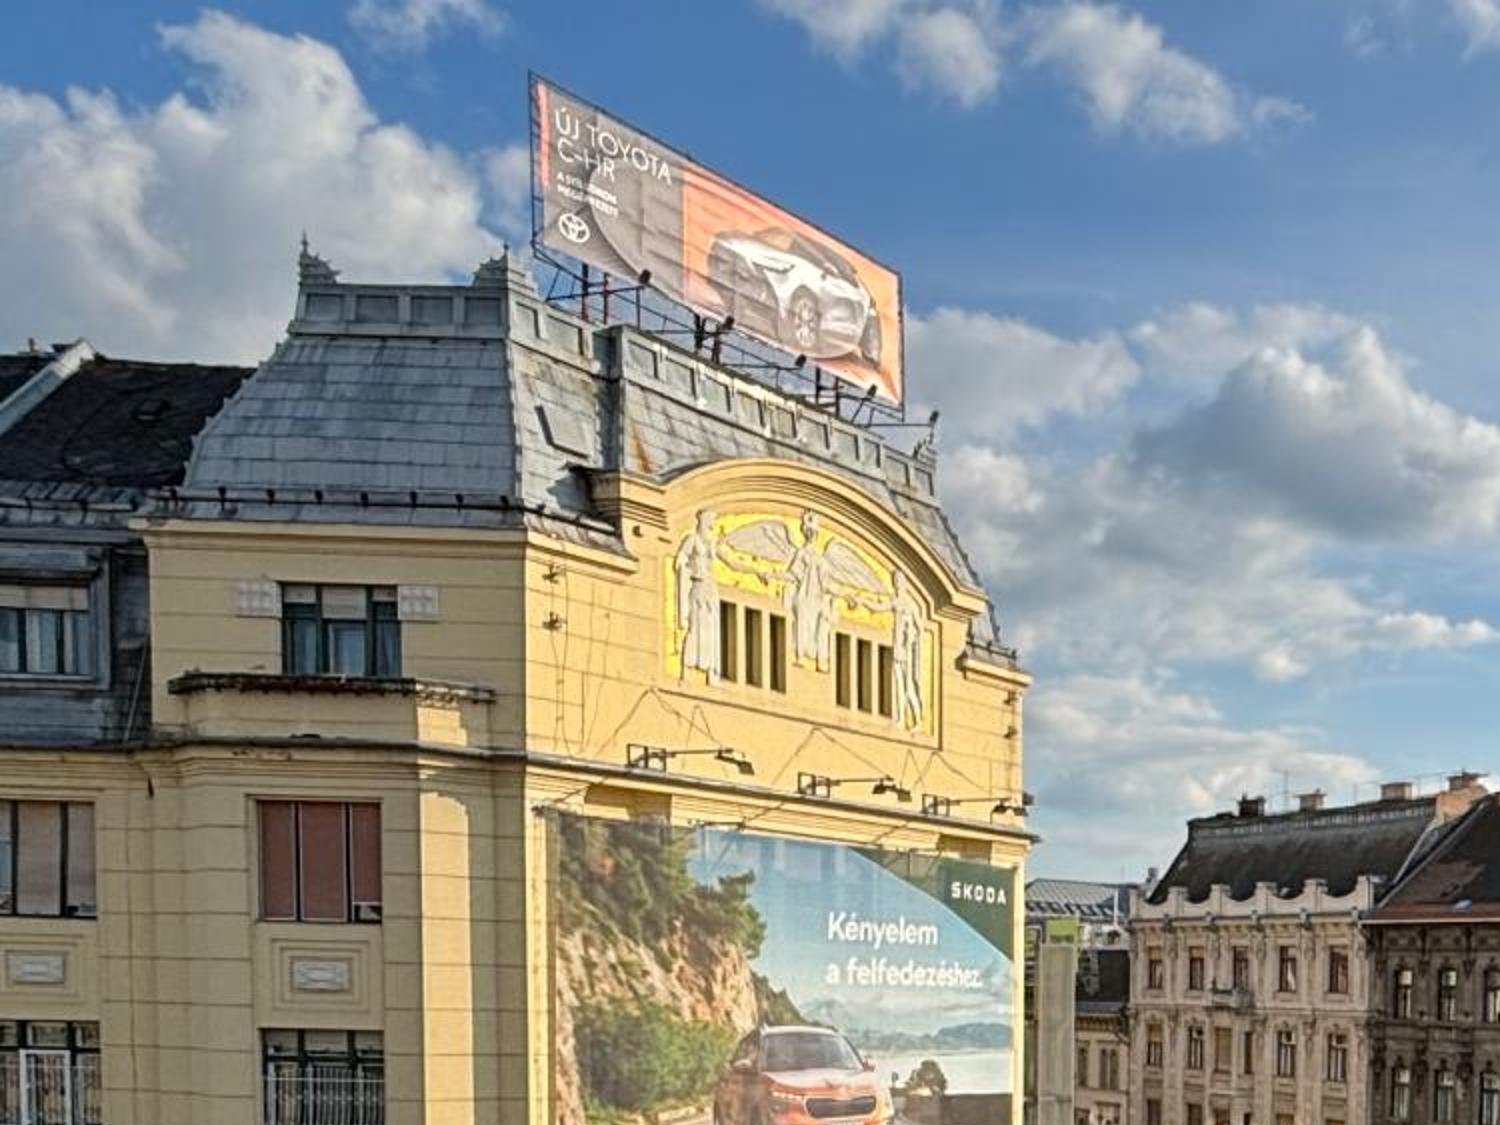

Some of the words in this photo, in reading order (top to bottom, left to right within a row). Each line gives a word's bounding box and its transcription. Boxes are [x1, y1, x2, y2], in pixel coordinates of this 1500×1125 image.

[556, 107, 579, 140] ÚJ
[586, 123, 672, 185] TOYOTA
[558, 138, 615, 183] C-HR
[827, 911, 939, 950] Kényelem
[826, 962, 841, 985] a
